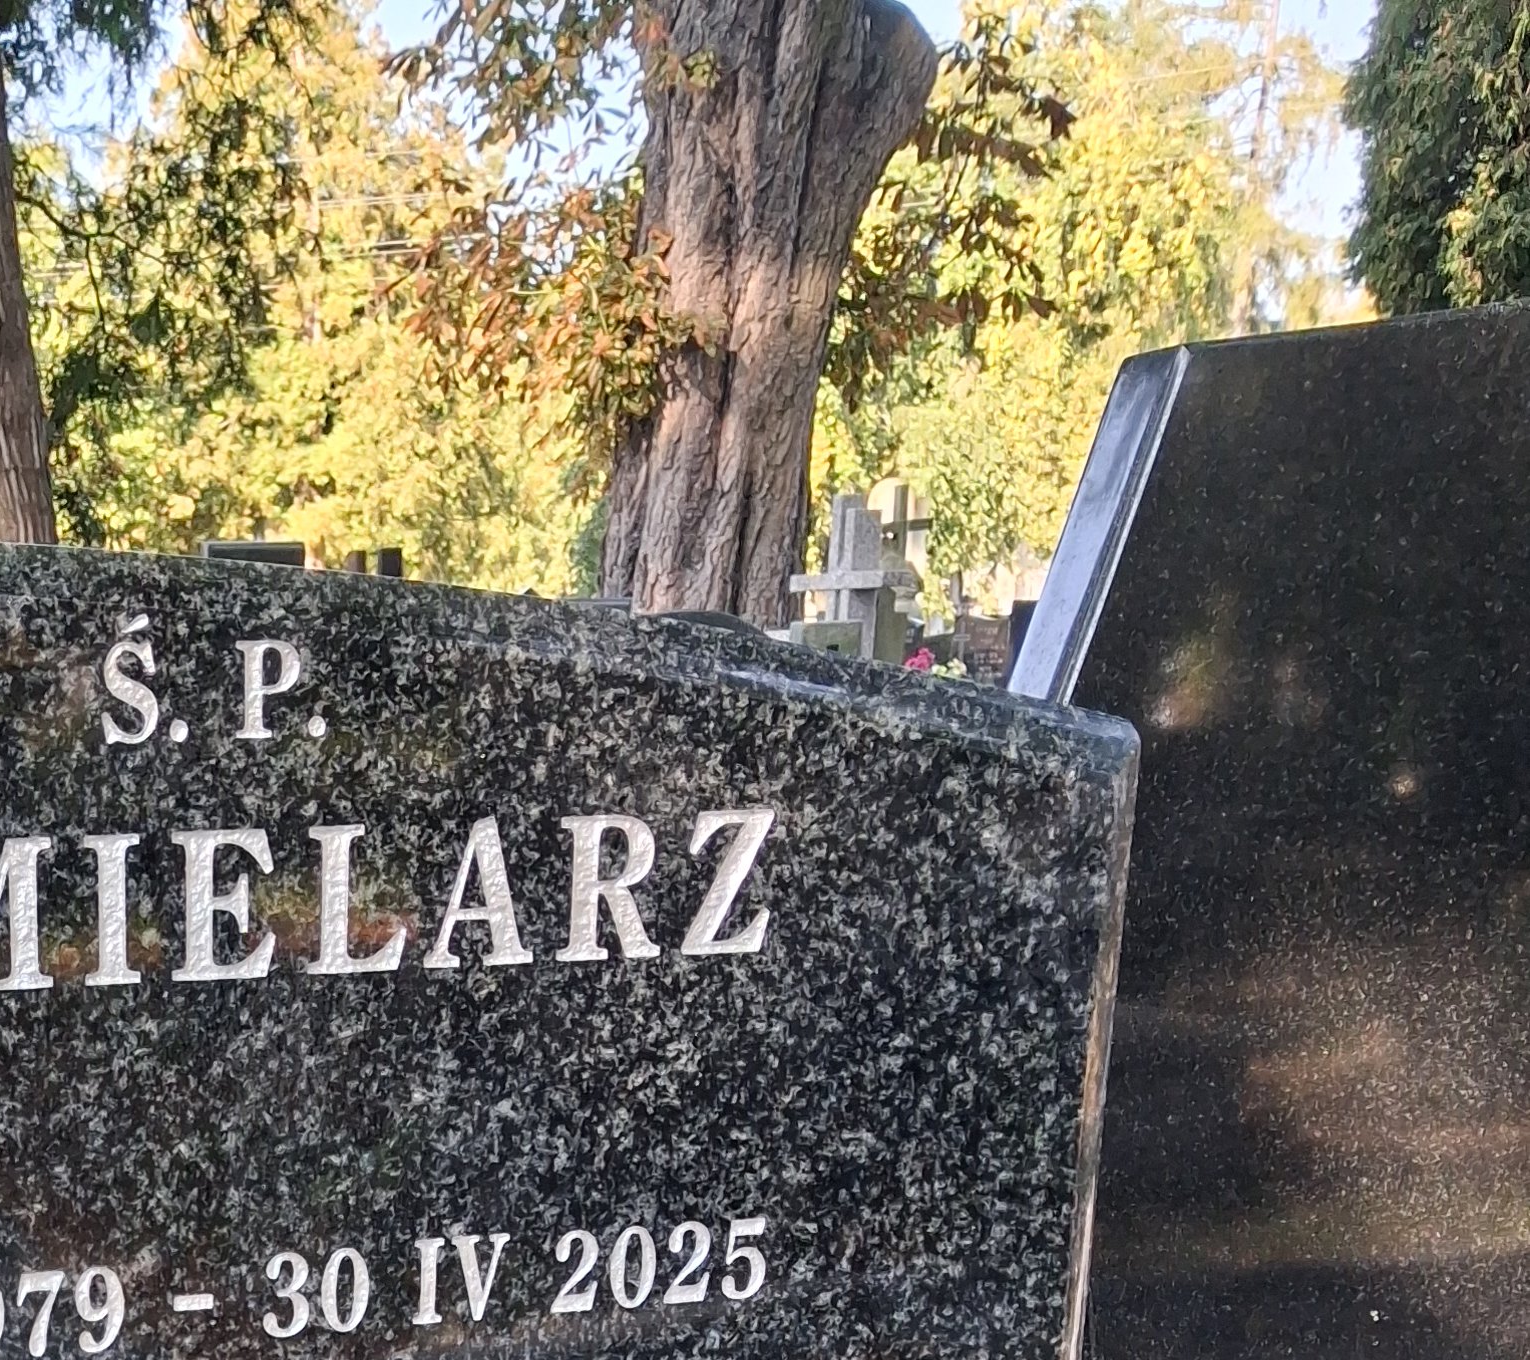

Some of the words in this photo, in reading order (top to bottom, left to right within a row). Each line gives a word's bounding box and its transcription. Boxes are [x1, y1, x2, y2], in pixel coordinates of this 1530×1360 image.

[100, 613, 190, 745] Ś.
[235, 638, 328, 740] P.
[262, 1247, 371, 1338] 30
[412, 1230, 511, 1325] IV
[550, 1216, 768, 1317] 2025
